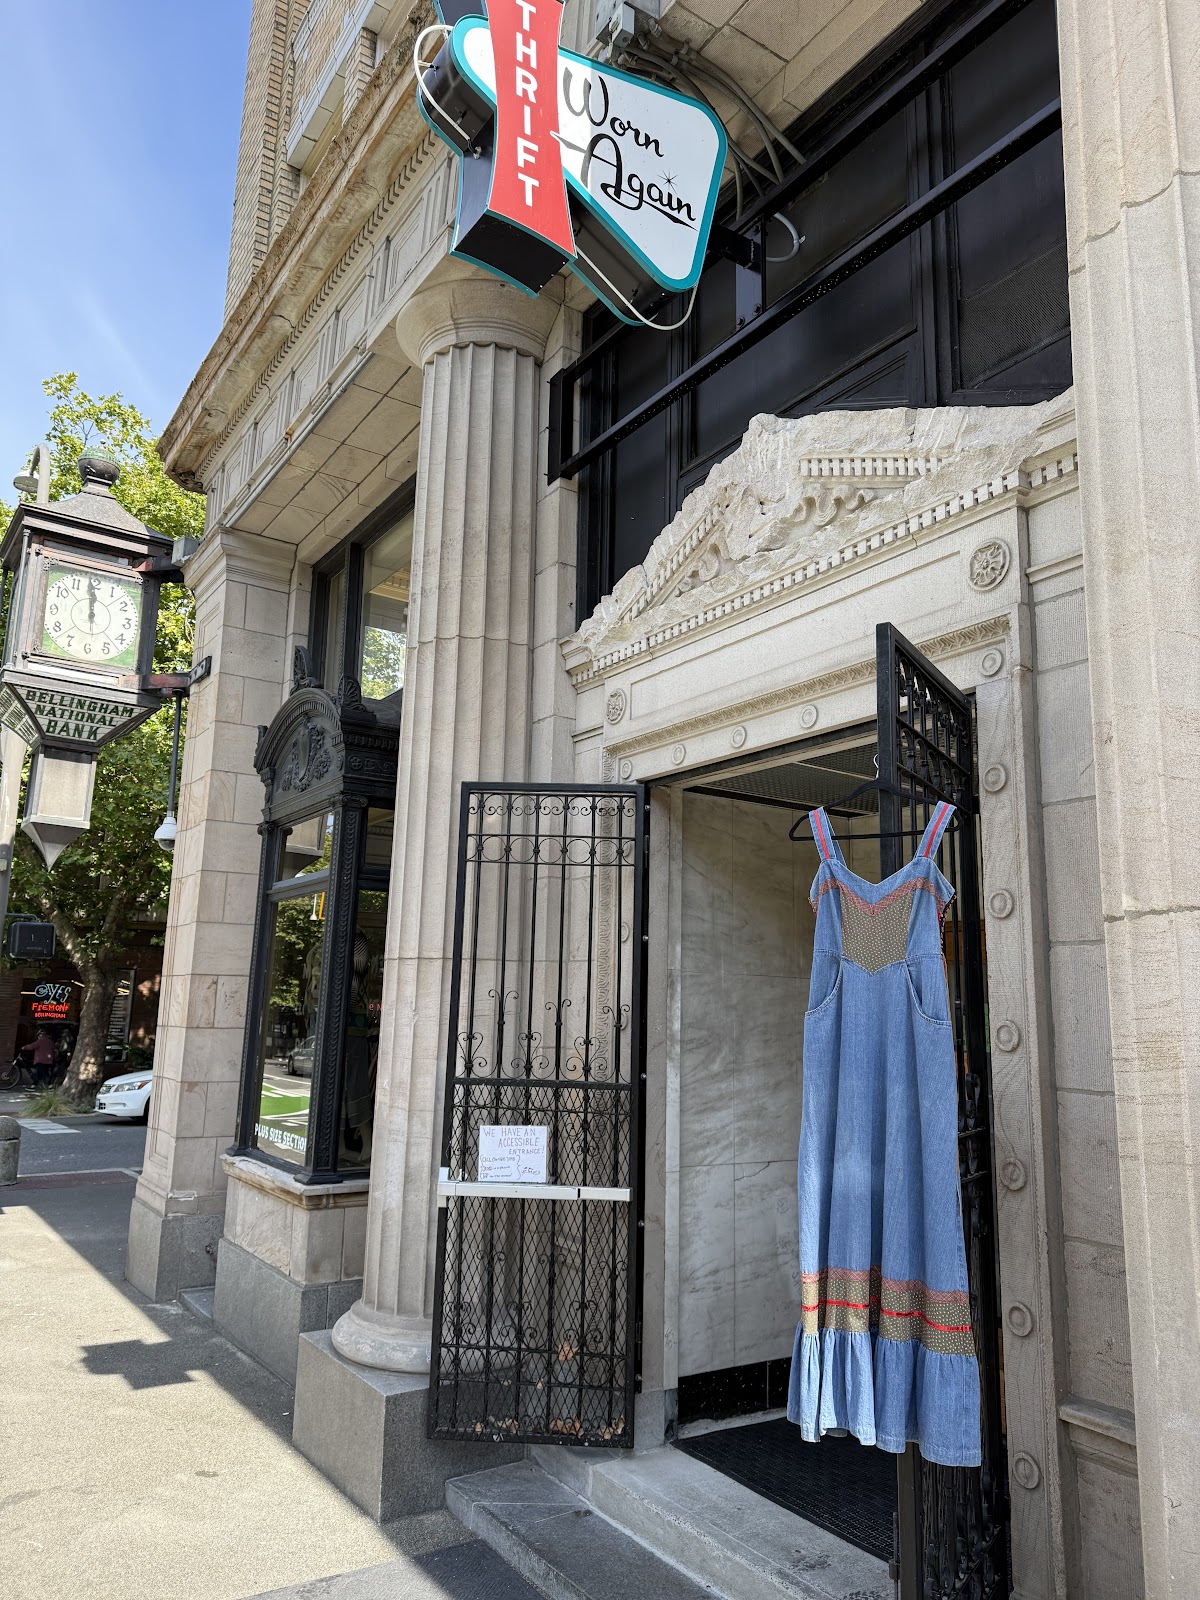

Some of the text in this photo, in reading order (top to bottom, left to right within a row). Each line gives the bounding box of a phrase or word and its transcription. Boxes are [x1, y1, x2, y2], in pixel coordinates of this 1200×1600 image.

[515, 0, 540, 207] THRIFT
[562, 66, 664, 158] Worn
[550, 132, 699, 232] Again
[56, 585, 70, 599] 10
[49, 604, 59, 615] 9
[119, 601, 128, 612] 2
[52, 620, 62, 633] 8
[122, 617, 133, 630] 3
[66, 634, 75, 647] 7
[115, 632, 127, 645] 4
[83, 643, 92, 655] 6
[101, 641, 111, 655] 5
[25, 689, 134, 718] BELLINGHAM
[34, 703, 117, 727] NATIONAL
[45, 719, 100, 741] BANK
[254, 1122, 269, 1140] PLUS
[269, 1127, 283, 1143] SIZE
[483, 1127, 536, 1137] WE HAVE AN
[498, 1137, 541, 1148] ACCESSIBLE
[508, 1146, 545, 1155] ENTRANCE!
